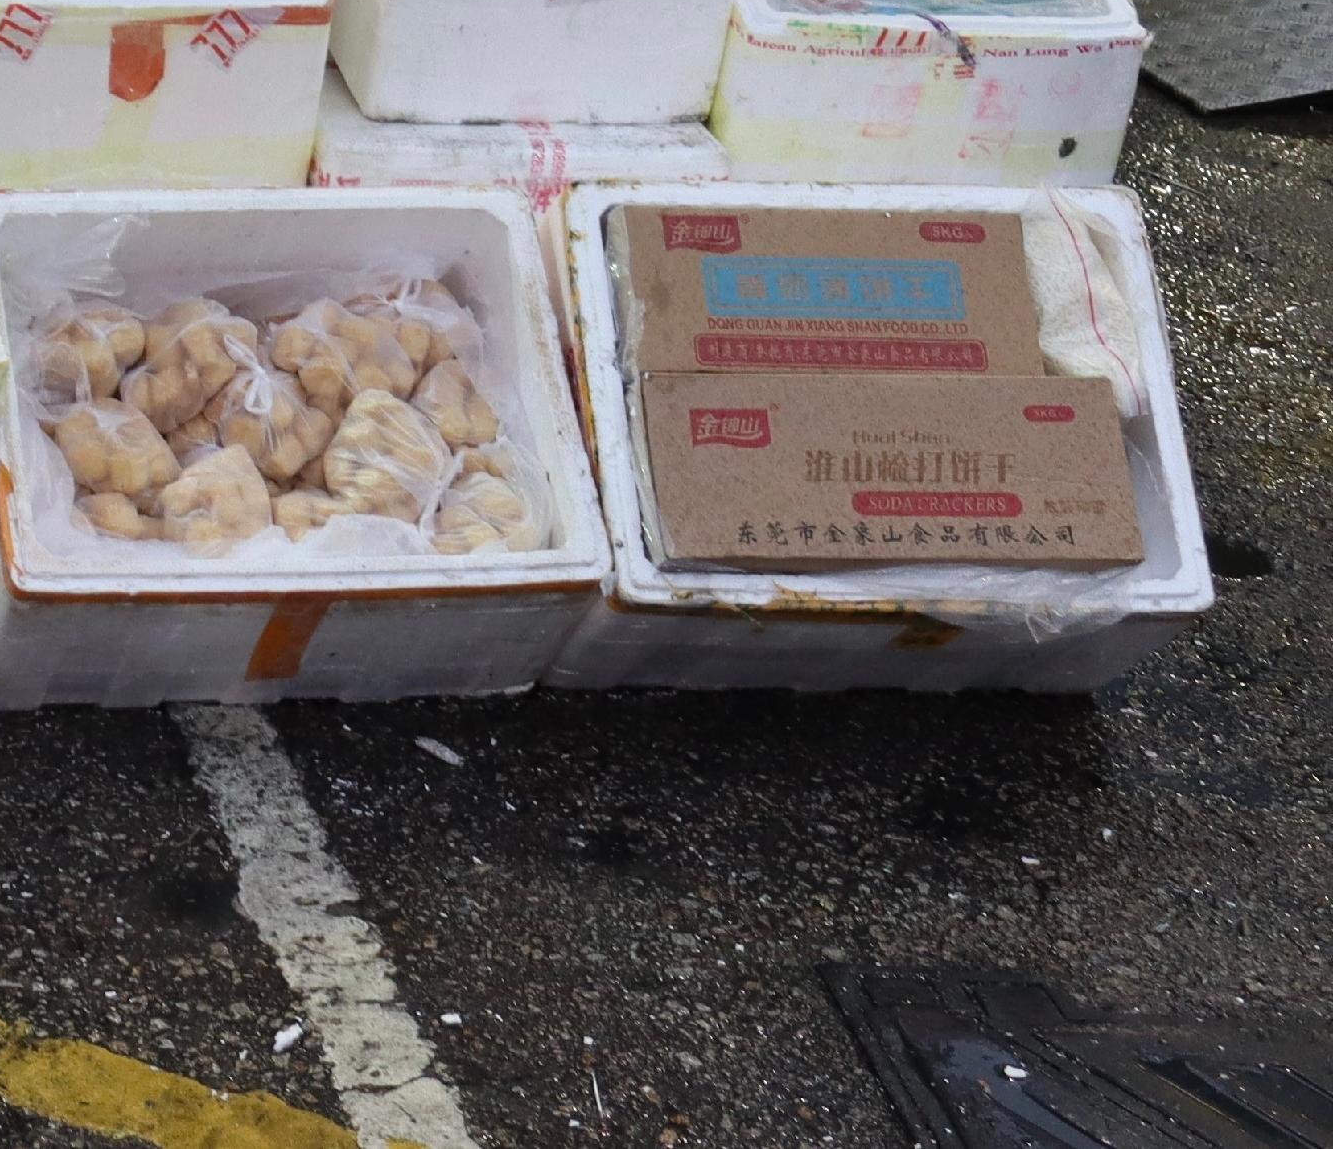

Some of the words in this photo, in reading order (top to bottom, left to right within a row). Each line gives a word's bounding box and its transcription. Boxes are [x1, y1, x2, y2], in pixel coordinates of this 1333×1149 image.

[190, 8, 251, 68] 777
[707, 318, 743, 331] DONG
[746, 319, 782, 332] GUAN
[785, 319, 805, 332] JIN
[806, 319, 844, 332] XIANG
[846, 320, 883, 333] SHAN
[885, 321, 919, 334] FOOD
[868, 496, 914, 512] SODA
[917, 496, 1008, 513] CRACKERS
[737, 522, 1076, 547] 东莞市金象山食品有限公司
